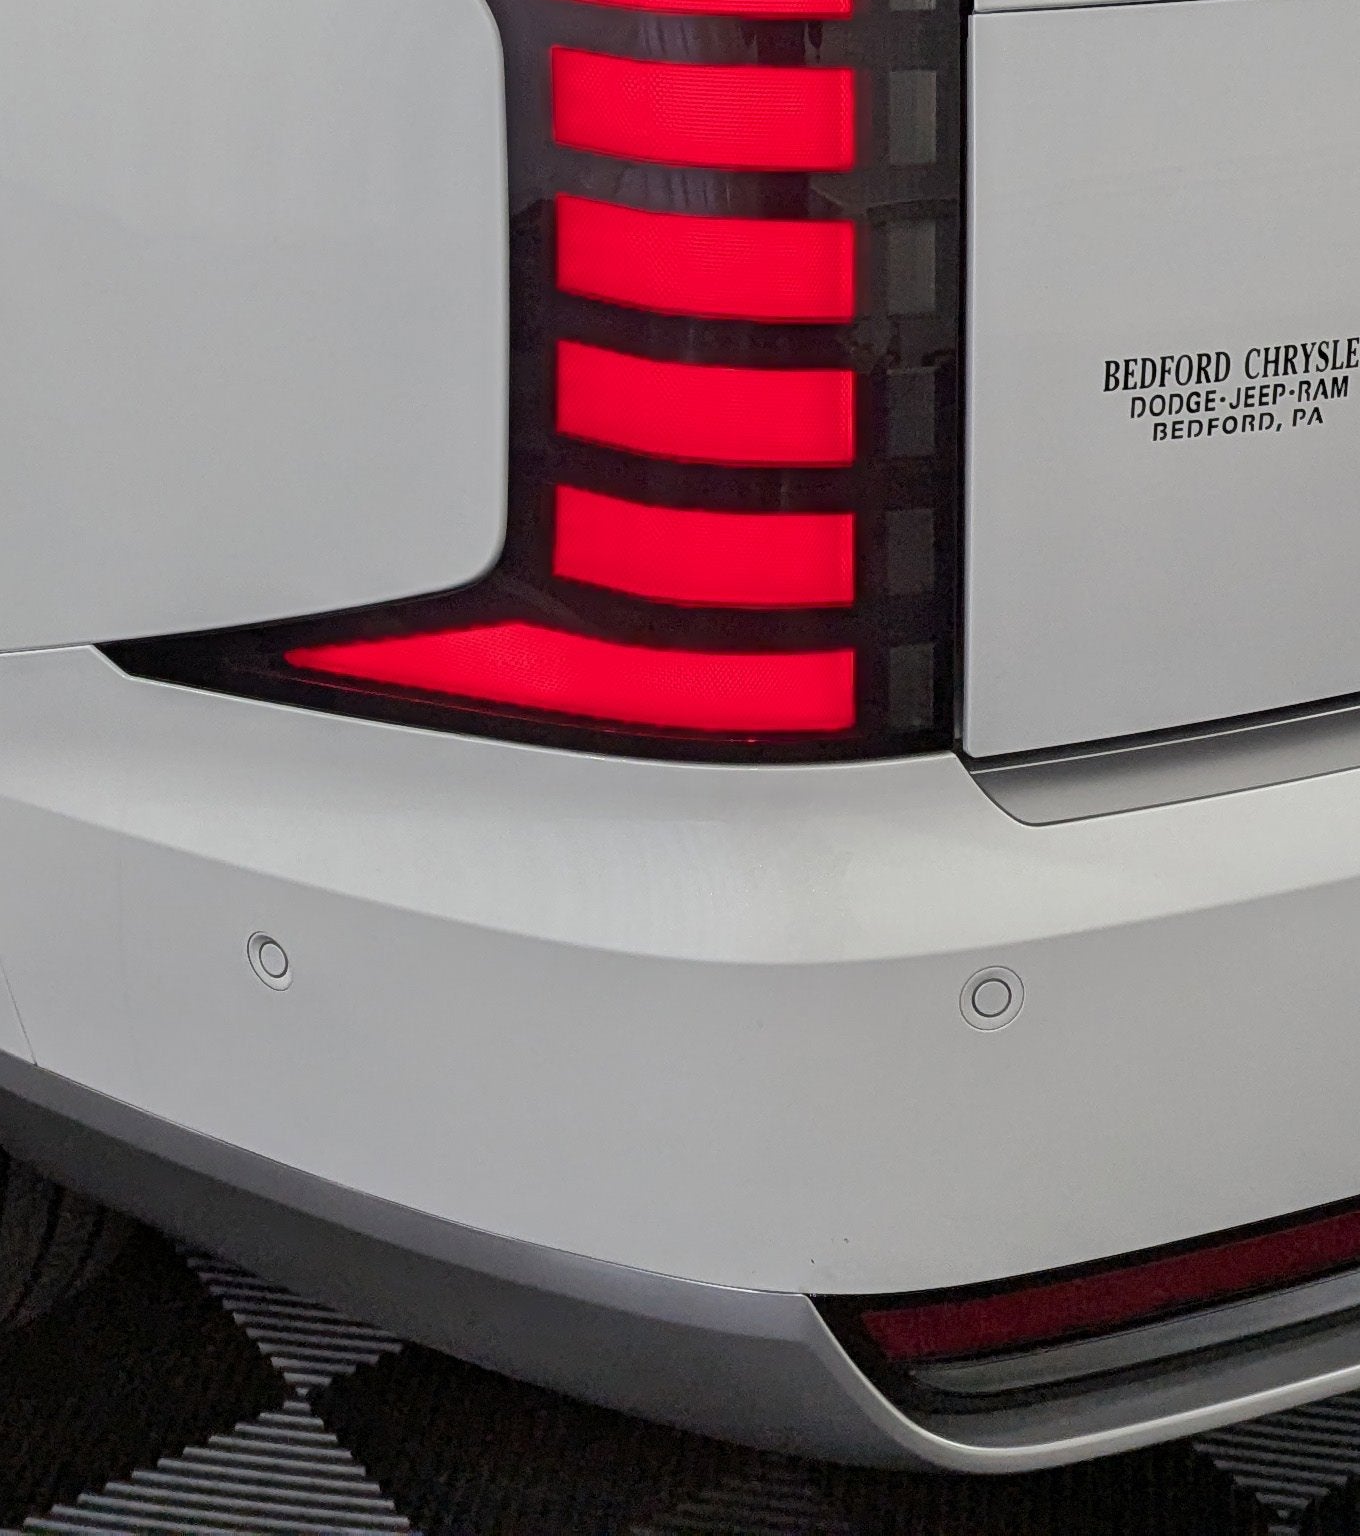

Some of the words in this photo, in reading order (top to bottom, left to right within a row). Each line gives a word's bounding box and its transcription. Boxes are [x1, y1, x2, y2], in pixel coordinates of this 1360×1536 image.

[1102, 350, 1232, 393] BEDFORD
[1151, 411, 1283, 442] BEDFORD,
[1291, 406, 1325, 427] PA
